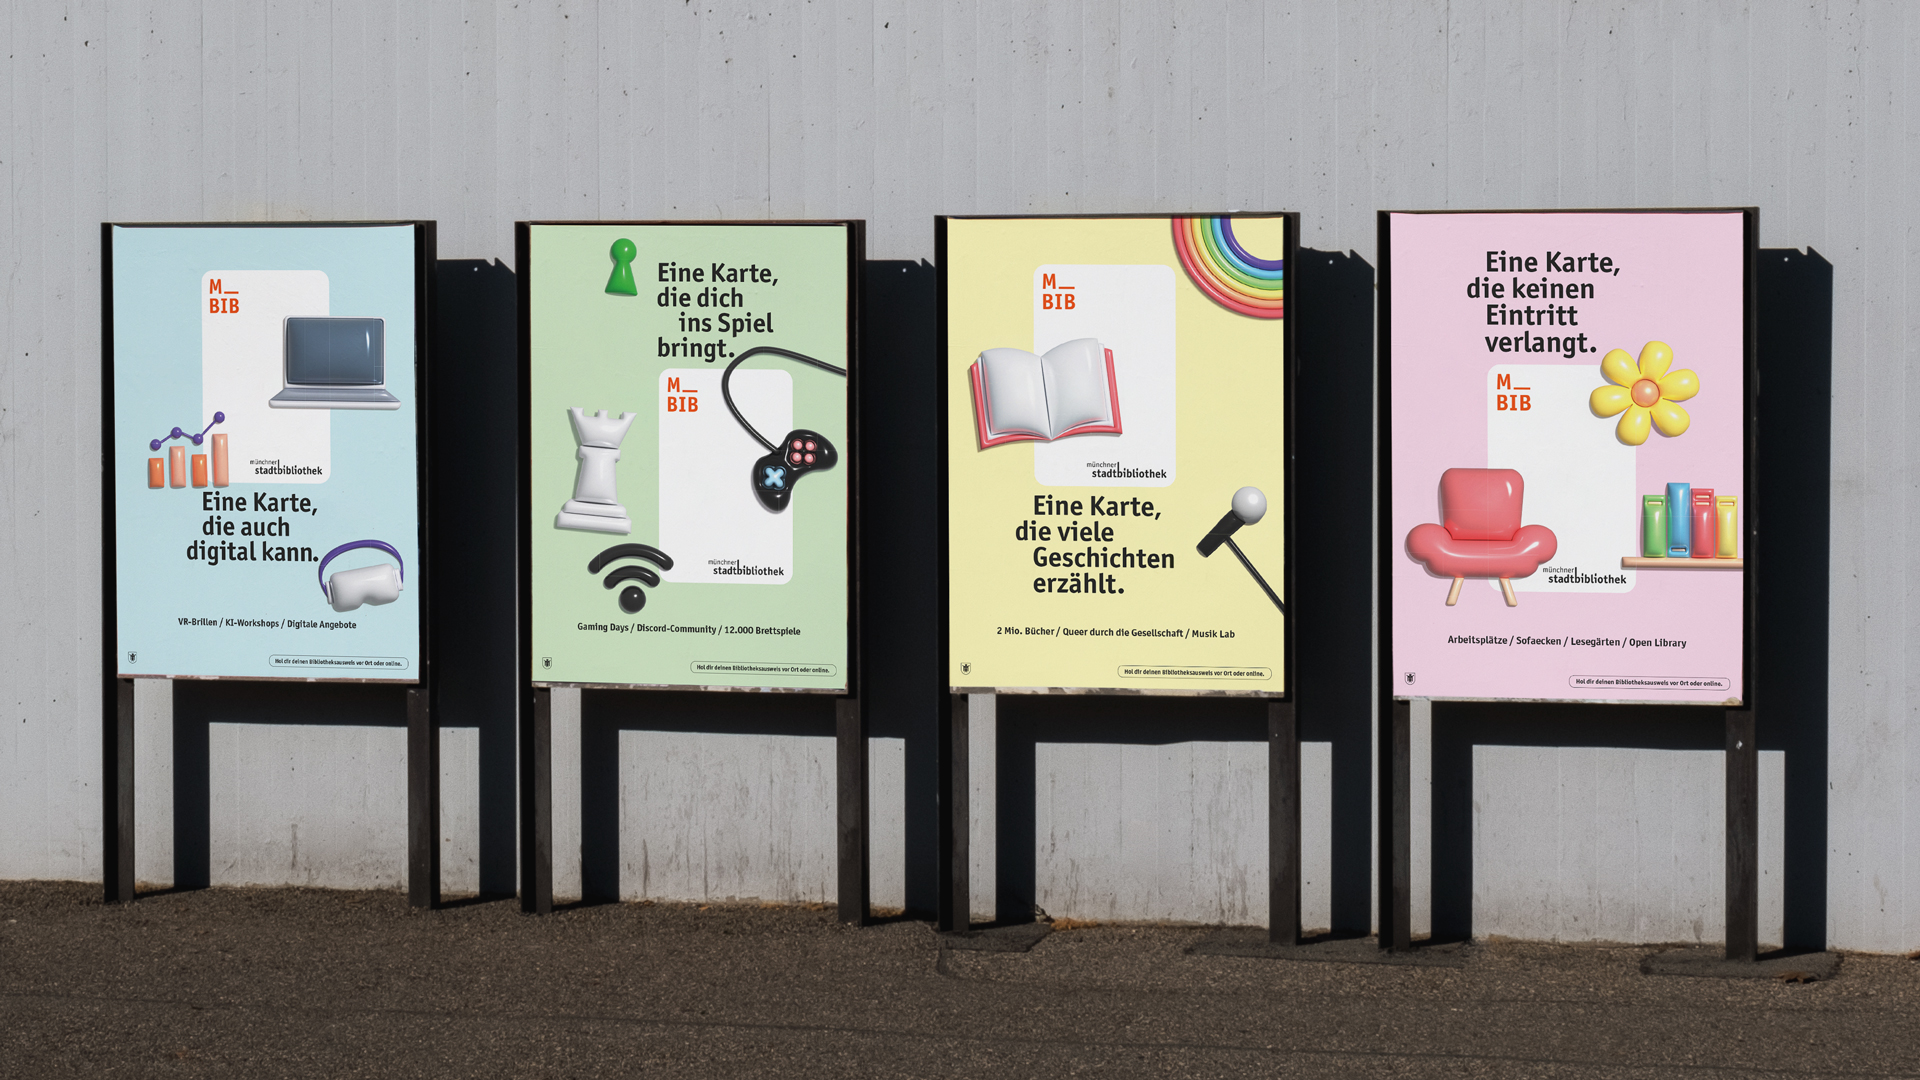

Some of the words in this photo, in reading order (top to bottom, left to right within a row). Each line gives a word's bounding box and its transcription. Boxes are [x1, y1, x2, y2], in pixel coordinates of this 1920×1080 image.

[1486, 250, 1538, 272] Eine
[1546, 251, 1620, 276] Karte,
[659, 262, 704, 282] Eine
[712, 263, 778, 286] Karte,
[657, 287, 691, 307] die
[697, 287, 743, 307] dich
[1467, 277, 1504, 298] die
[1513, 277, 1594, 299] keinen
[210, 298, 239, 313] BIB
[1043, 294, 1075, 309] BIB
[679, 311, 711, 332] ins
[718, 312, 774, 337] Spiel
[1487, 303, 1578, 326] Eintritt
[658, 337, 735, 363] bringt.
[1485, 331, 1596, 358] verlangt.
[668, 397, 698, 412] BIB
[1497, 395, 1531, 411] BIB
[255, 459, 322, 475] stadtbibliothek
[1092, 462, 1166, 478] stadtbibliothek
[203, 491, 246, 511] Eine
[254, 492, 317, 516] Karte,
[1034, 494, 1083, 515] Eine
[1091, 496, 1161, 520] Karte,
[203, 515, 235, 536] die
[241, 516, 289, 536] auch
[1016, 520, 1051, 541] die
[1057, 521, 1114, 542] viele
[187, 540, 256, 566] digital
[263, 541, 318, 562] kann.
[1034, 547, 1174, 568] Geschichten
[713, 559, 784, 576] stadtbibliothek
[1548, 567, 1627, 584] stadtbibliothek
[1034, 573, 1124, 594] erzählt.
[178, 618, 217, 626] VR-Brillen
[226, 619, 279, 629] KI-Workshops
[288, 620, 317, 629] Digitale
[319, 621, 356, 630] Angebote
[578, 623, 608, 632] Gaming
[610, 623, 629, 633] Days
[637, 624, 716, 635] Discord-Community
[725, 626, 753, 634] 12.000
[756, 627, 800, 636] Brettspiele
[1025, 627, 1054, 635] Bücher
[1063, 628, 1088, 636] Queer
[1090, 628, 1113, 636] durch
[1131, 629, 1183, 637] Gesellschaft
[1220, 630, 1235, 638] Lab
[1448, 635, 1507, 645] Arbeitsplätze
[1516, 636, 1561, 645] Sofaecken
[1571, 637, 1620, 647] Lesegärten
[1629, 638, 1652, 648] Open
[1655, 639, 1686, 649] Library
